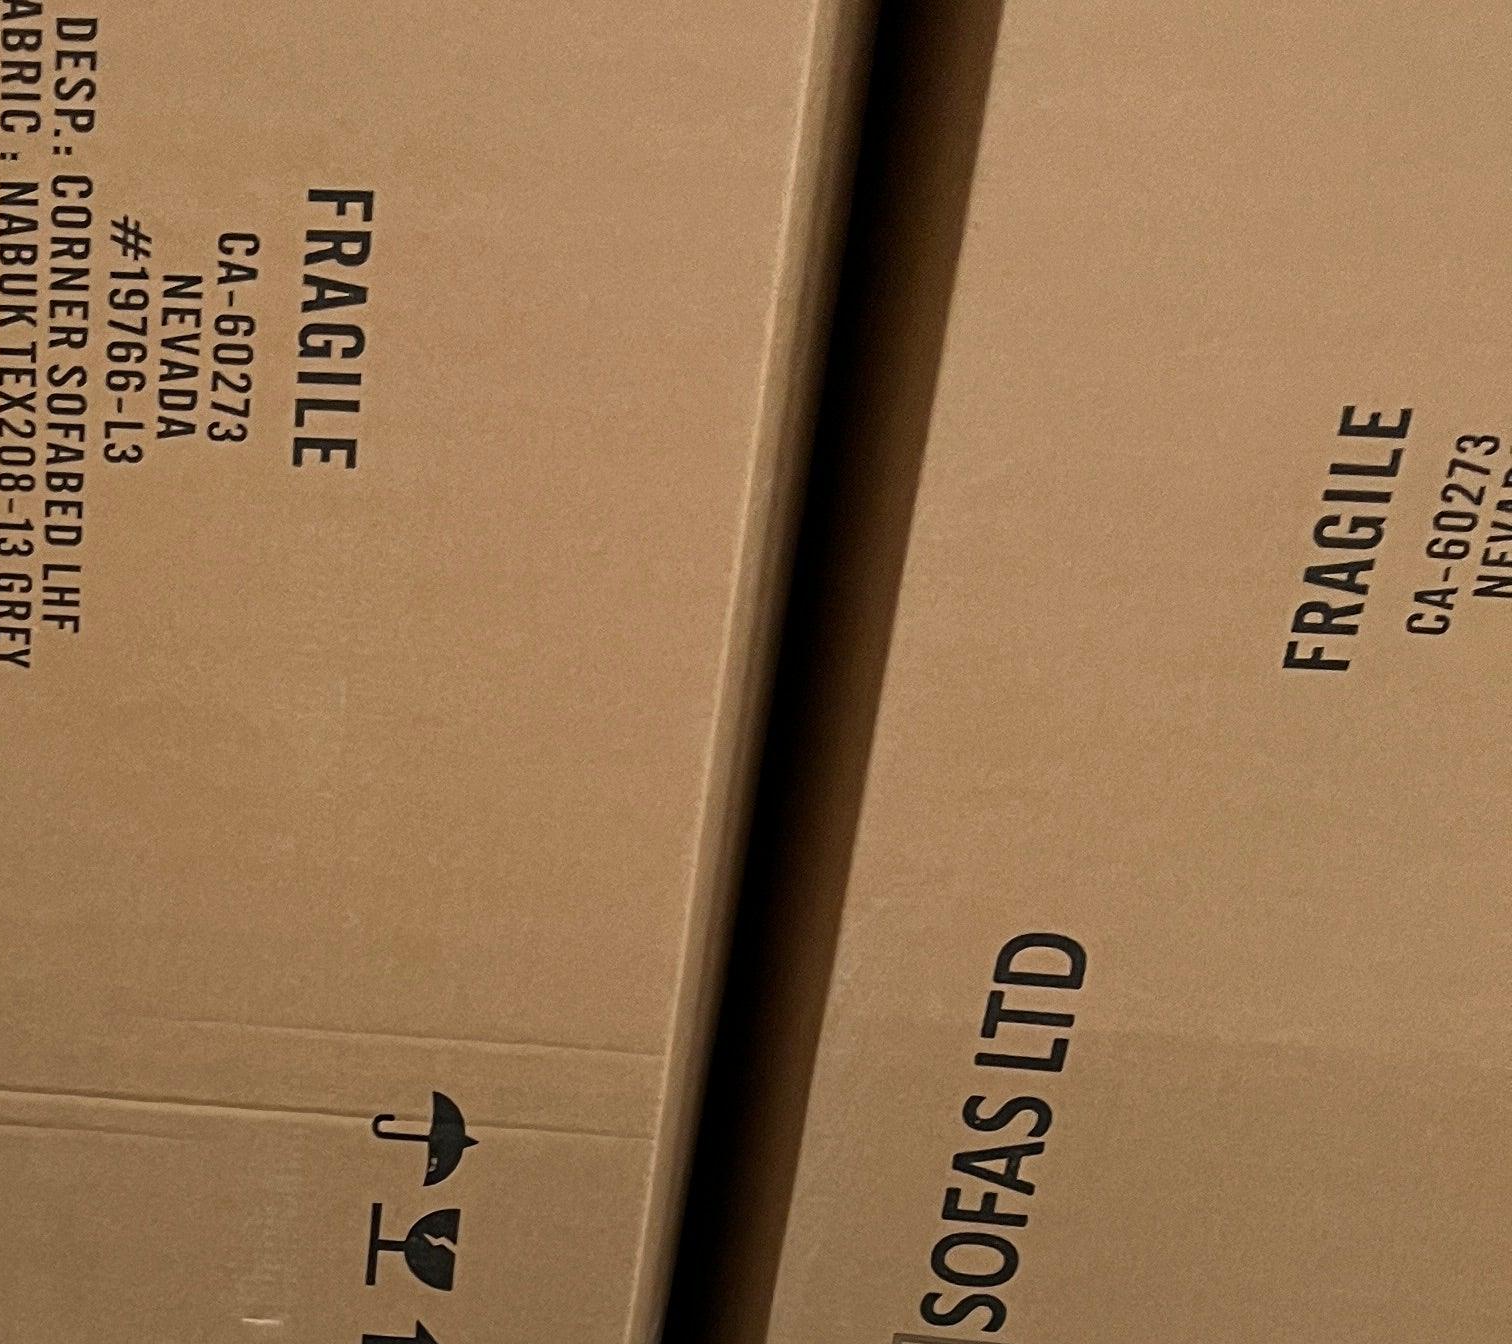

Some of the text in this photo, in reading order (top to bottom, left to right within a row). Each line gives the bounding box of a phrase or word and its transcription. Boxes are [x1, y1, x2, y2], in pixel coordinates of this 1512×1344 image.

[41, 17, 98, 634] DESP.: CORNER SOFABED LHF
[103, 214, 153, 464] #19766-L3
[156, 275, 204, 440] NEVADA
[206, 232, 261, 443] CA-60273
[292, 188, 375, 469] FRAGILE
[1283, 405, 1413, 674] FRAGILE
[1405, 434, 1501, 636] CA-60273
[973, 931, 1088, 1073] LTD
[919, 1092, 1055, 1333] SOFAS
